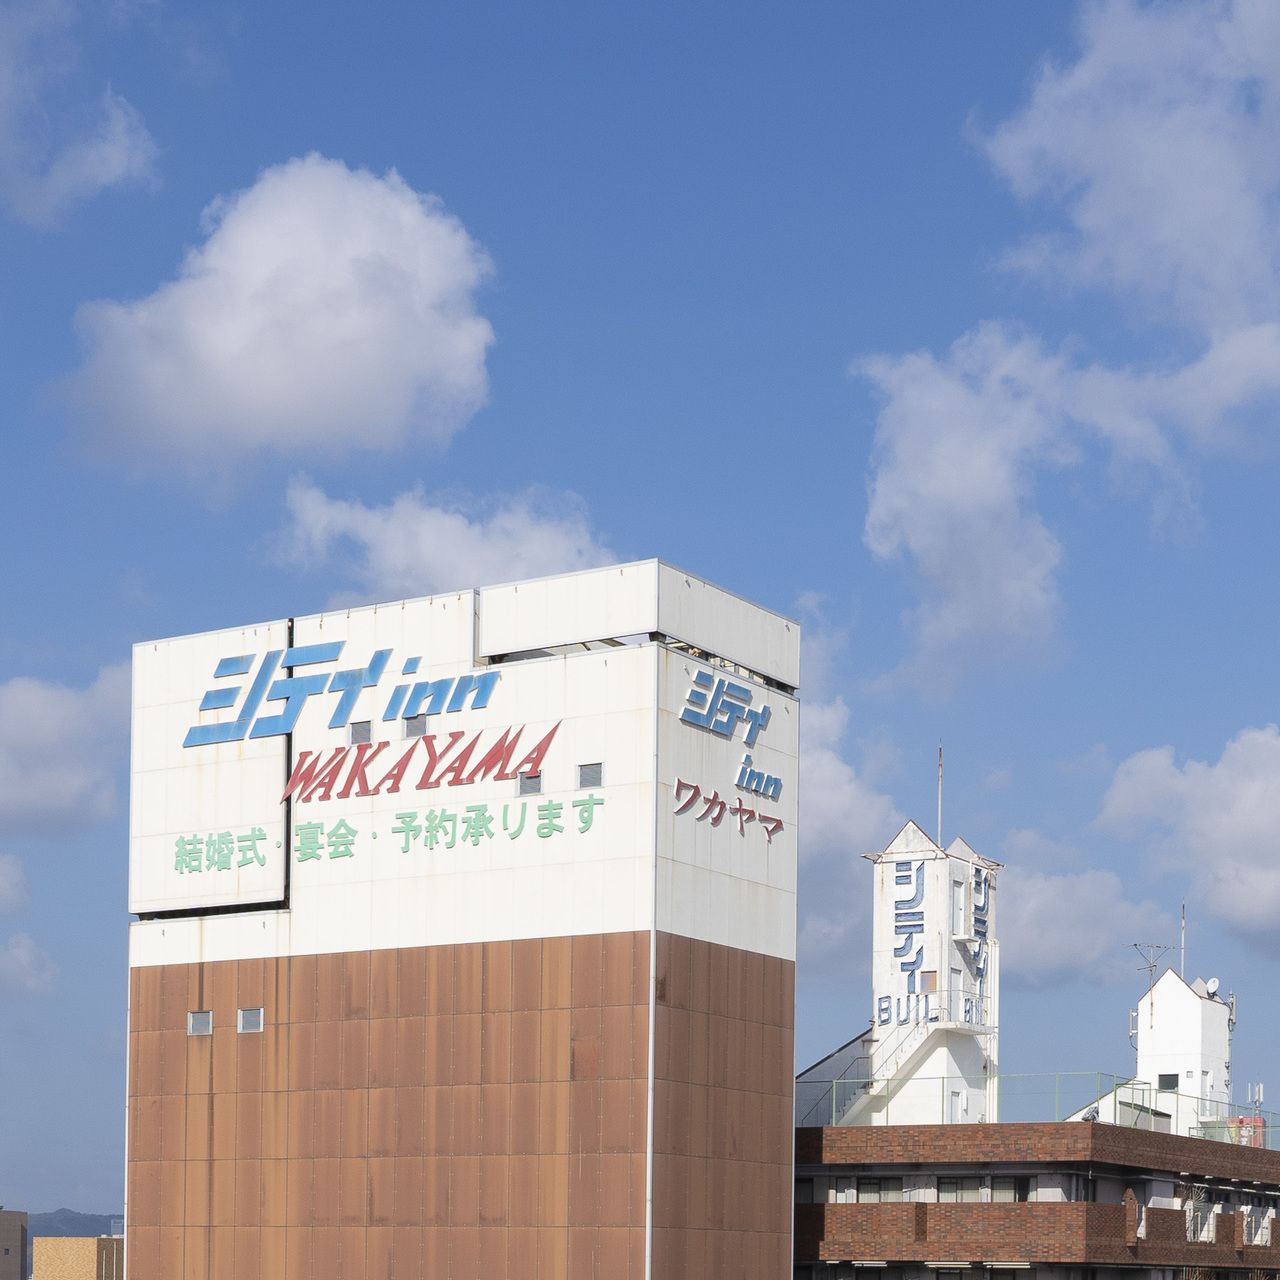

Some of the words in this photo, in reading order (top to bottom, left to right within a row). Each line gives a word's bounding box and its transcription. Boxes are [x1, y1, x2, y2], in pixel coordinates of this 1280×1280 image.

[382, 656, 502, 722] inn
[280, 719, 564, 804] WAKAYAMA
[735, 753, 783, 801] inn
[673, 776, 785, 844] ワカヤマ
